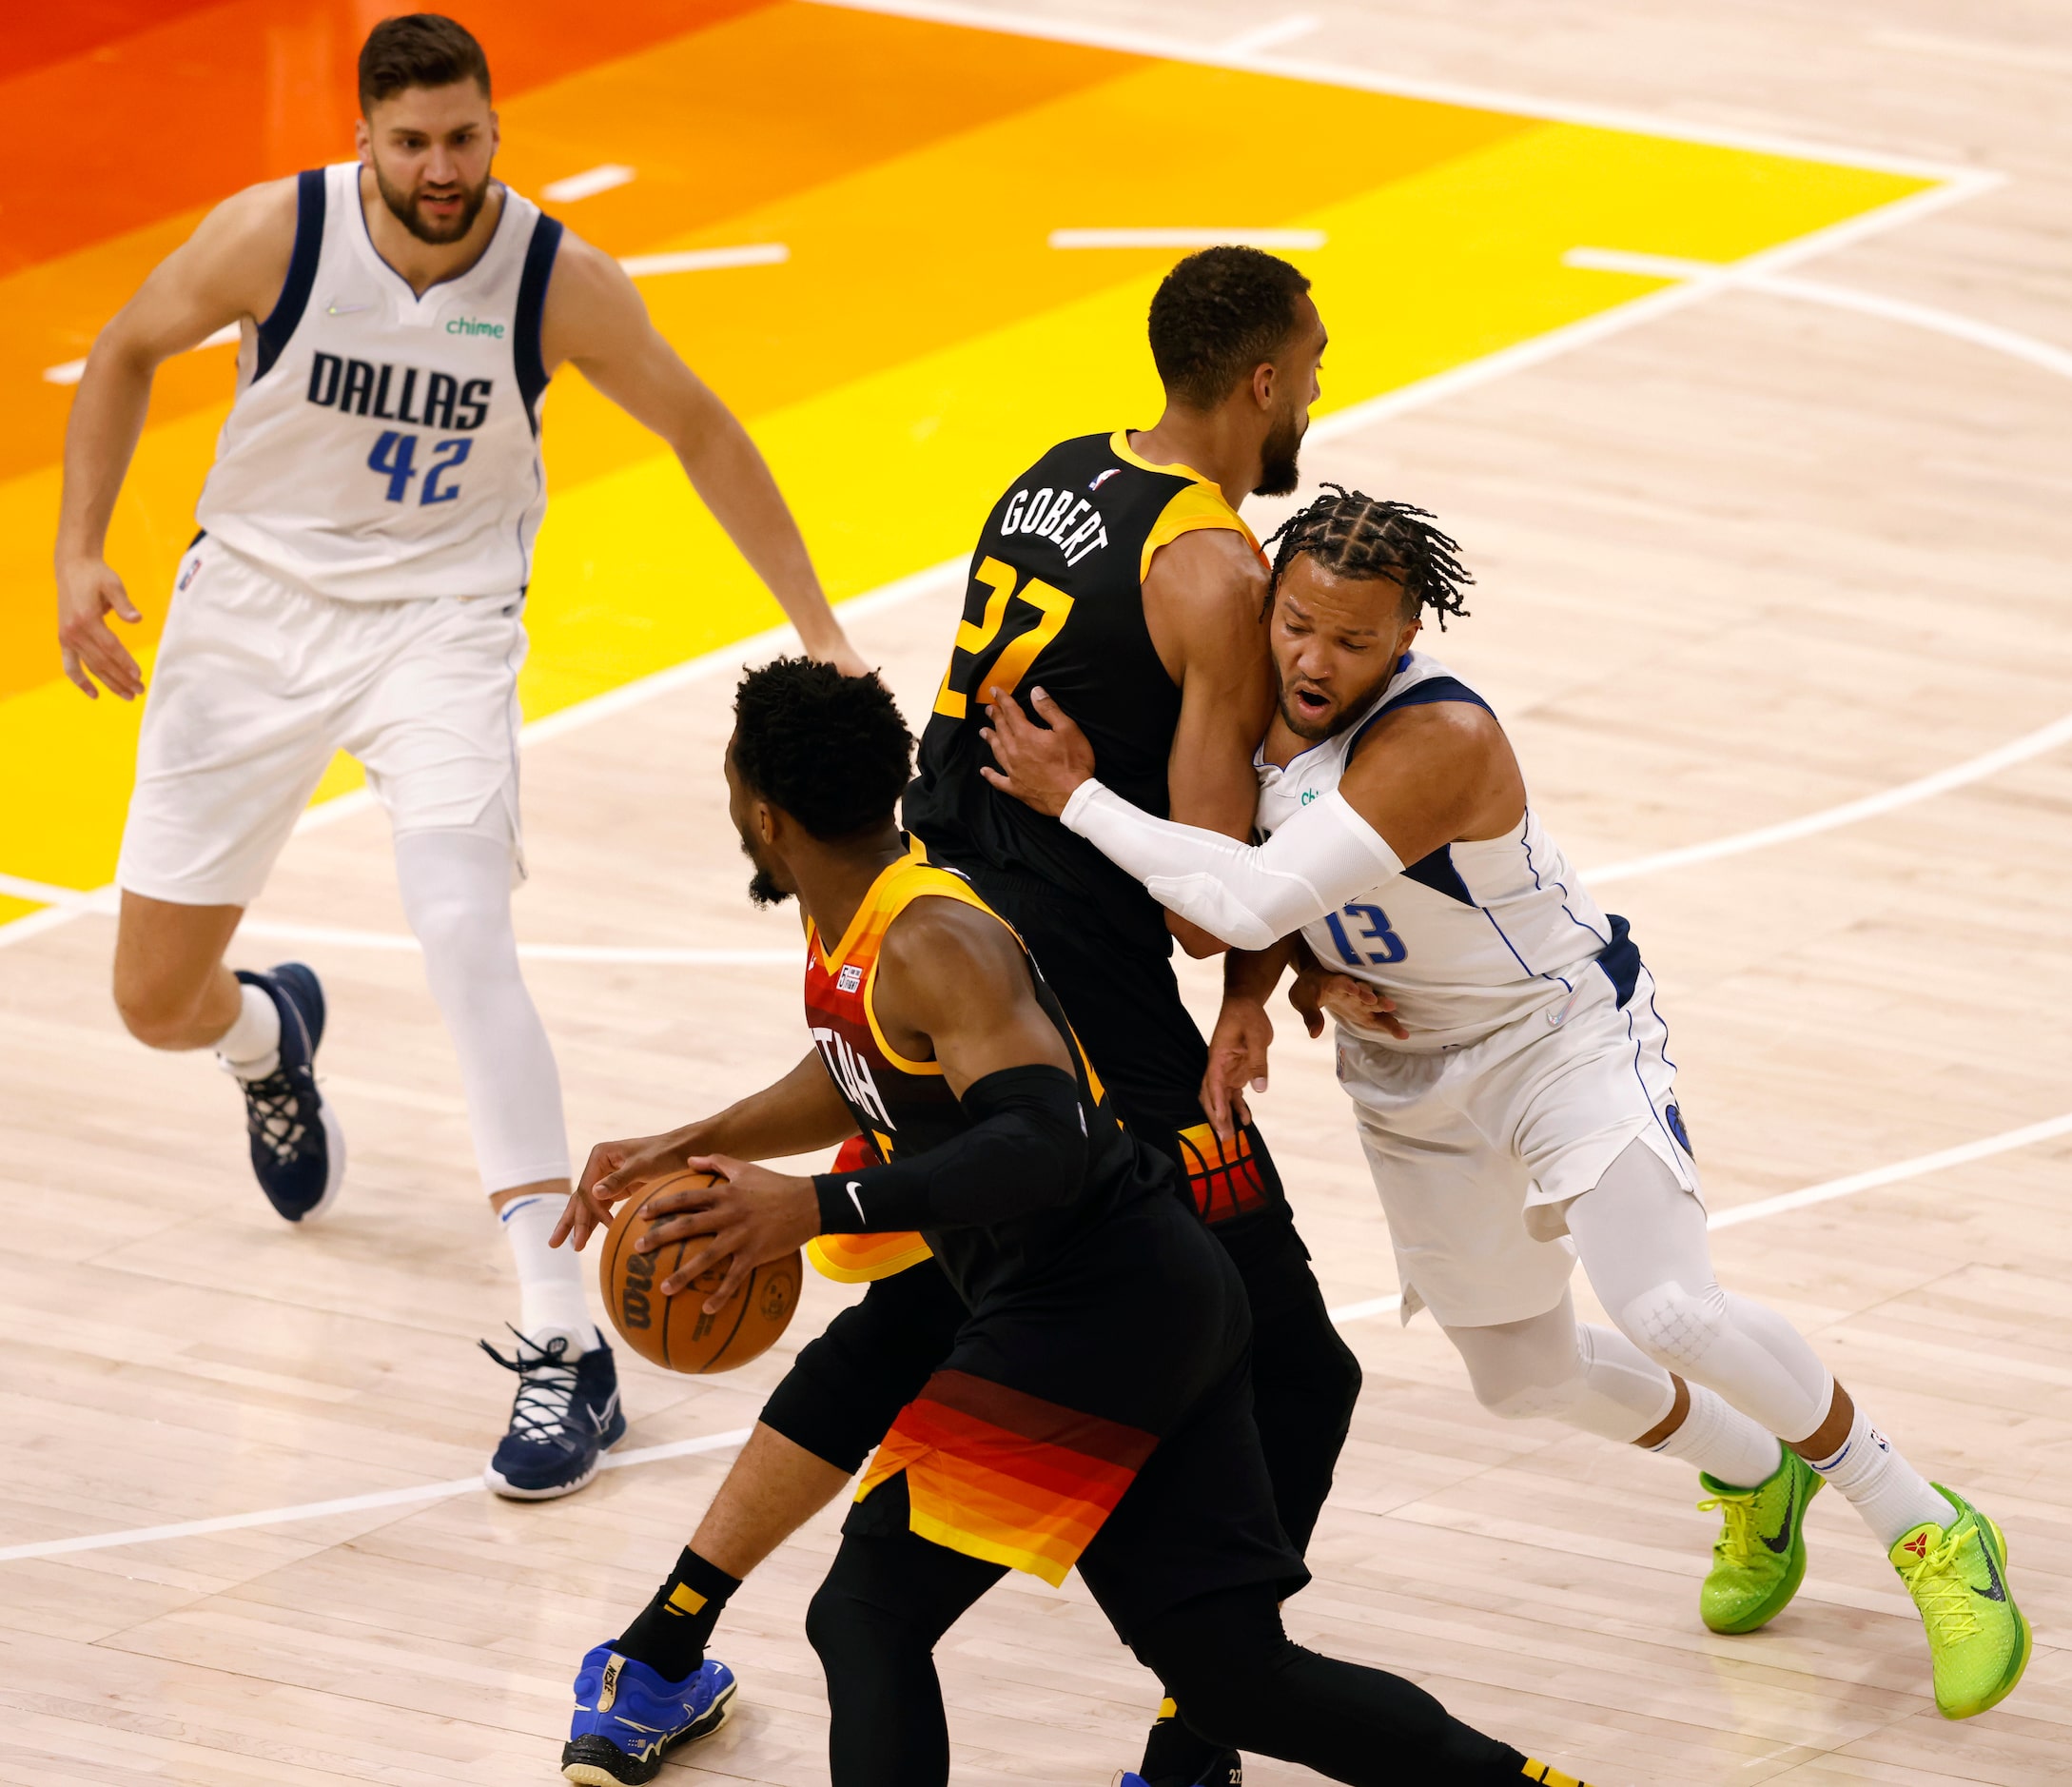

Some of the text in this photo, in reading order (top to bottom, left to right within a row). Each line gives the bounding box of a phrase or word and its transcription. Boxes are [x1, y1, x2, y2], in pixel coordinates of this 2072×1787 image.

[446, 316, 505, 340] chime
[306, 350, 494, 431] DALLAS
[367, 430, 474, 506] 42
[1001, 487, 1109, 568] GOBERT
[933, 555, 1076, 719] 27
[1323, 903, 1408, 967] 13
[811, 1027, 897, 1131] TAH
